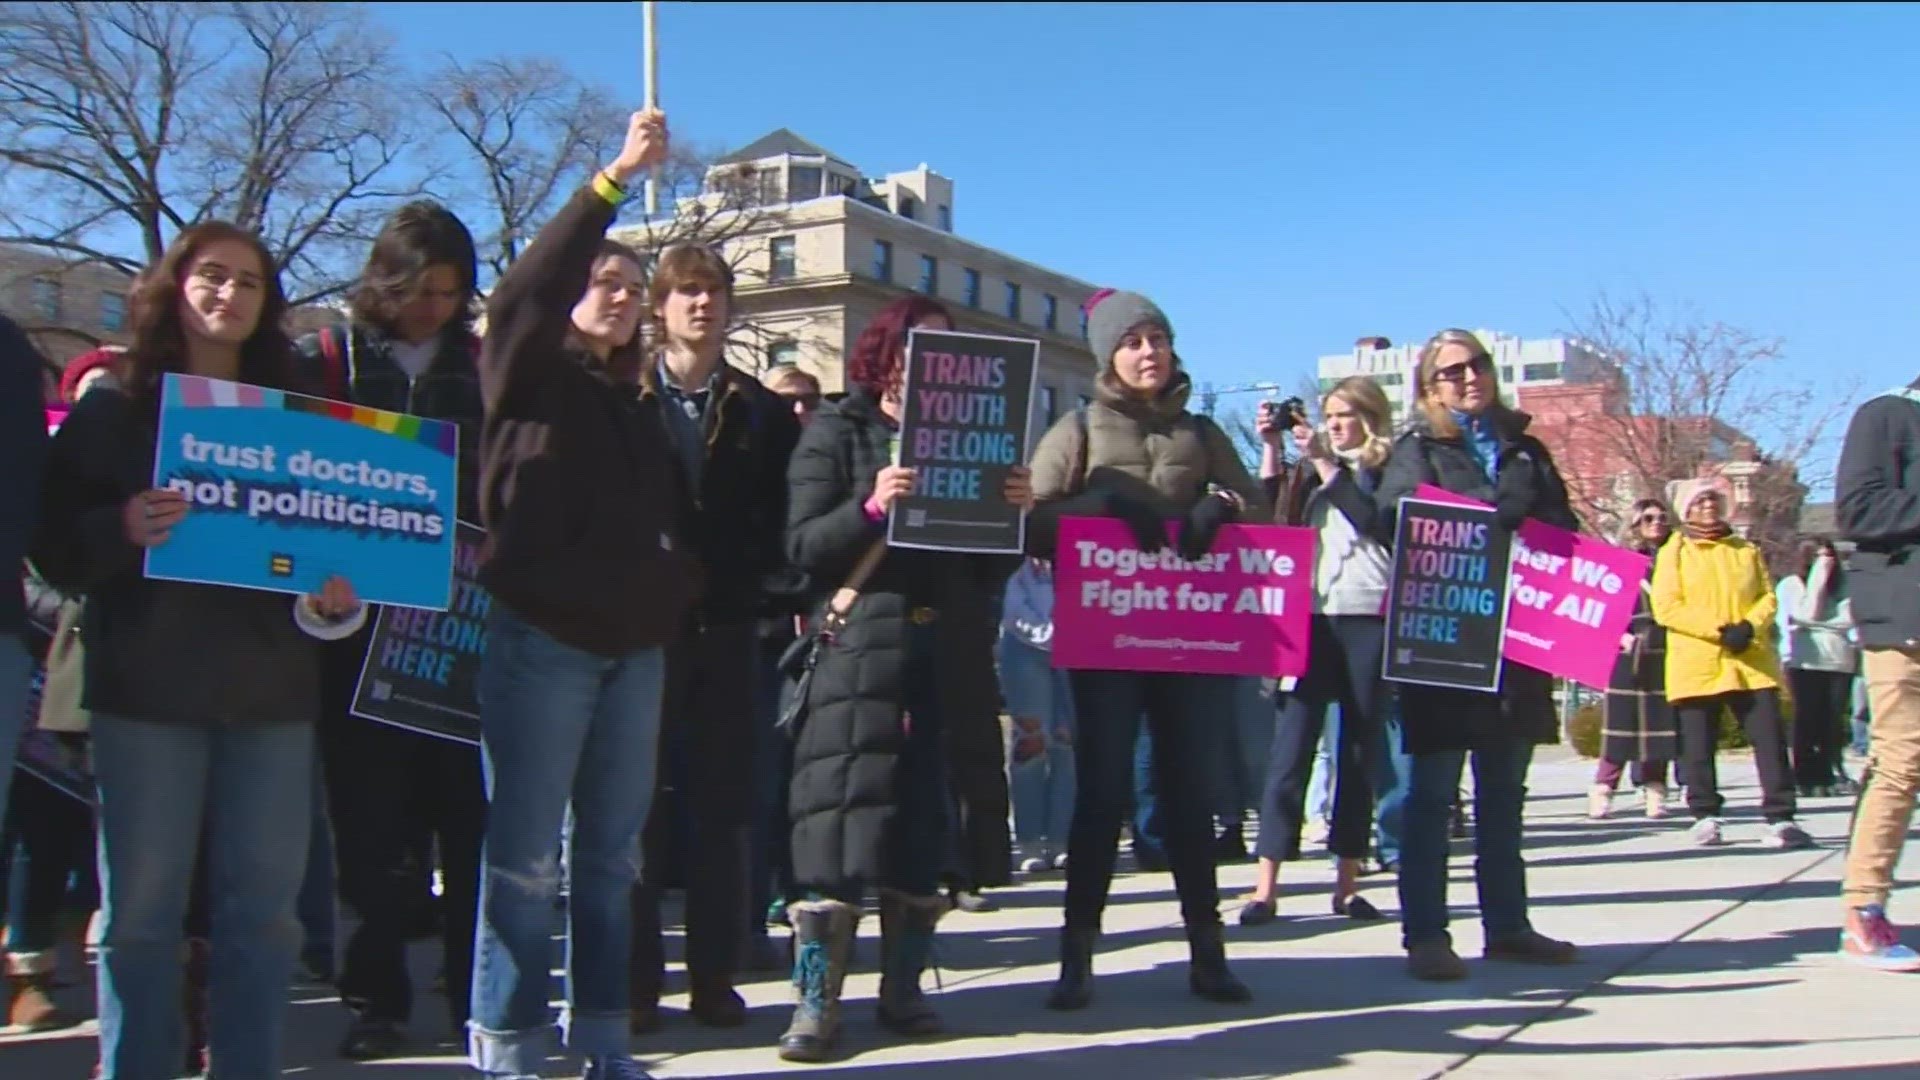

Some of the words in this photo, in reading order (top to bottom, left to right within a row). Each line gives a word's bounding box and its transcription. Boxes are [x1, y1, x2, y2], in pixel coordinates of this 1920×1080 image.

[922, 351, 1007, 388] TRANS
[917, 389, 1007, 426] YOUTH
[914, 428, 1016, 465] BELONG
[181, 433, 276, 472] trust
[287, 450, 438, 501] doctors,
[912, 465, 982, 500] HERE
[167, 478, 238, 508] not
[248, 487, 443, 537] politicians
[1408, 516, 1488, 550] TRANS
[1238, 547, 1296, 576] We
[1406, 549, 1487, 583] YOUTH
[1571, 556, 1623, 595] We
[1081, 579, 1169, 616] Fight
[1175, 583, 1228, 612] for
[1233, 586, 1286, 616] All
[1402, 580, 1496, 616] BELONG
[1552, 594, 1607, 628] All
[1398, 612, 1460, 644] HERE
[381, 637, 457, 688] HERE
